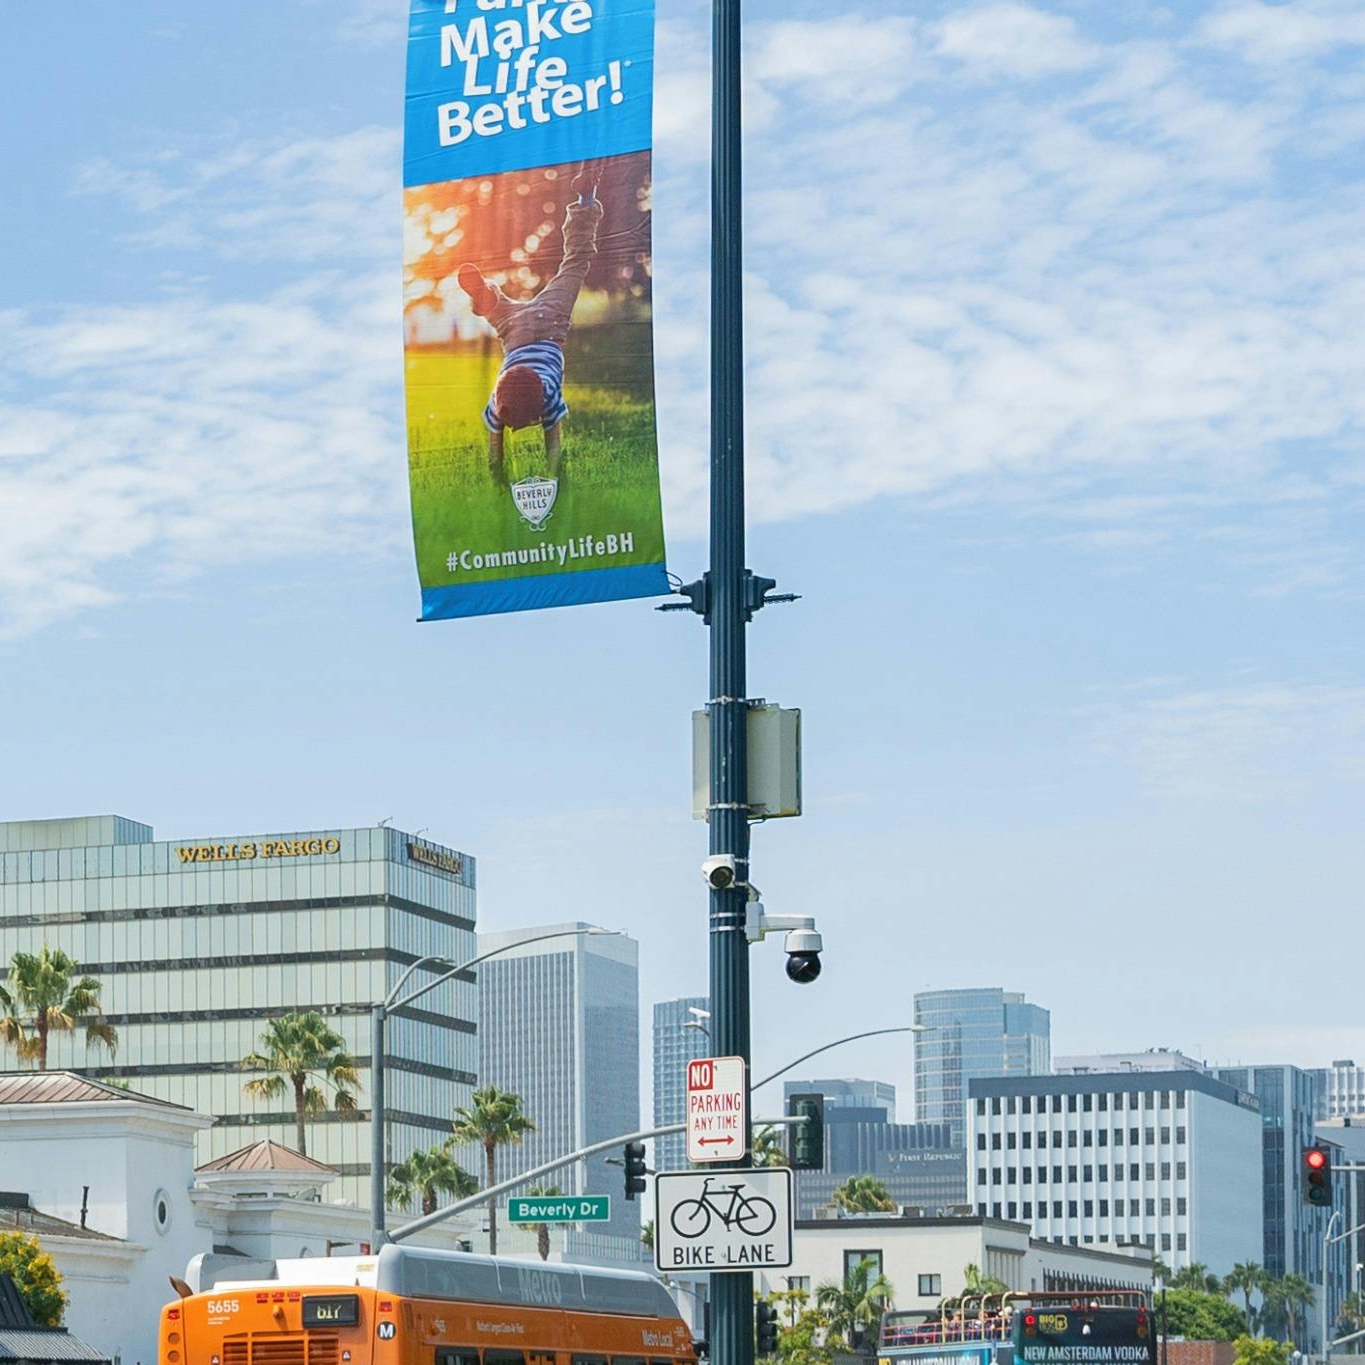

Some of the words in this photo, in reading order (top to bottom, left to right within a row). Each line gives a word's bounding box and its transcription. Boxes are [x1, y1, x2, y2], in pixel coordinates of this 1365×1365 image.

[440, 1, 593, 67] Make
[463, 45, 567, 97] Life
[437, 60, 624, 147] Better!
[517, 488, 552, 501] BEVERLY
[522, 499, 548, 510] HILLS
[446, 532, 634, 572] #CommunityLifeBH
[175, 842, 257, 864] WELLS
[260, 837, 341, 858] FARGO
[690, 1064, 711, 1088] NO
[690, 1092, 741, 1114] PARKING
[694, 1116, 713, 1131] ANY
[717, 1115, 738, 1130] TIME
[518, 1202, 576, 1219] Beverly
[580, 1202, 599, 1216] Dr
[673, 1245, 715, 1265] BIKE
[726, 1244, 775, 1264] LANE
[518, 1266, 562, 1305] Metro
[207, 1300, 240, 1314] 5655
[379, 1323, 395, 1339] M
[1024, 1346, 1046, 1361] NEW
[1048, 1345, 1112, 1361] AMSTERDAM
[1114, 1345, 1149, 1361] VODKA
